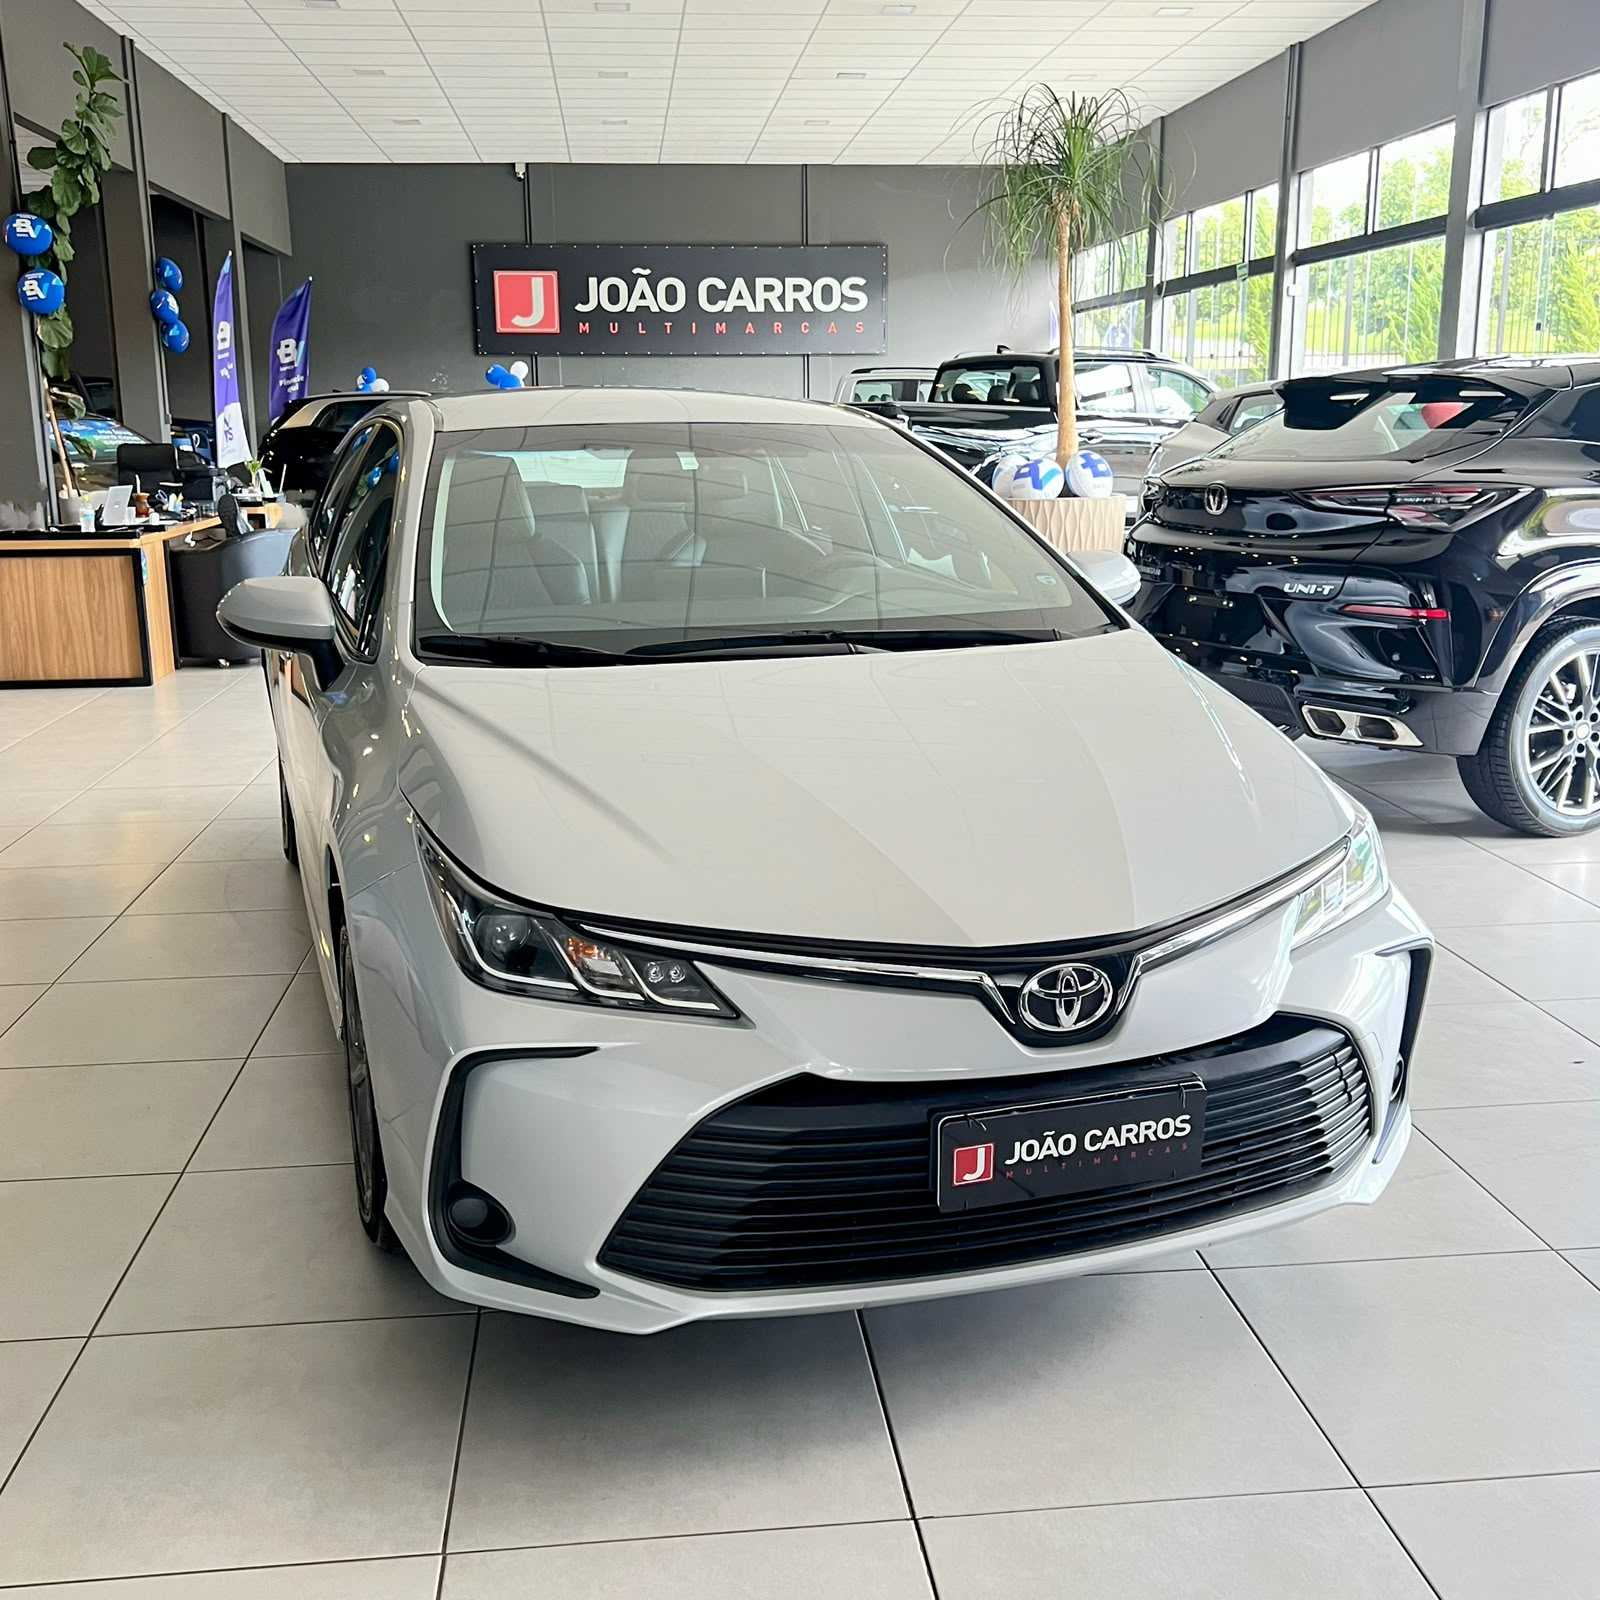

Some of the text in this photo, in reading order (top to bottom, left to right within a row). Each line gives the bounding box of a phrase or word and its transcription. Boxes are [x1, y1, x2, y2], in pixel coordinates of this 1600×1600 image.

[511, 276, 544, 328] J
[574, 267, 869, 313] JOÃO CARROS
[578, 321, 865, 335] MULTIMARCAS
[1283, 582, 1335, 595] UNI-T
[1004, 1114, 1192, 1166] JOÃO CARROS
[962, 1146, 986, 1182] J
[1006, 1142, 1188, 1180] MULTIMARCAS
